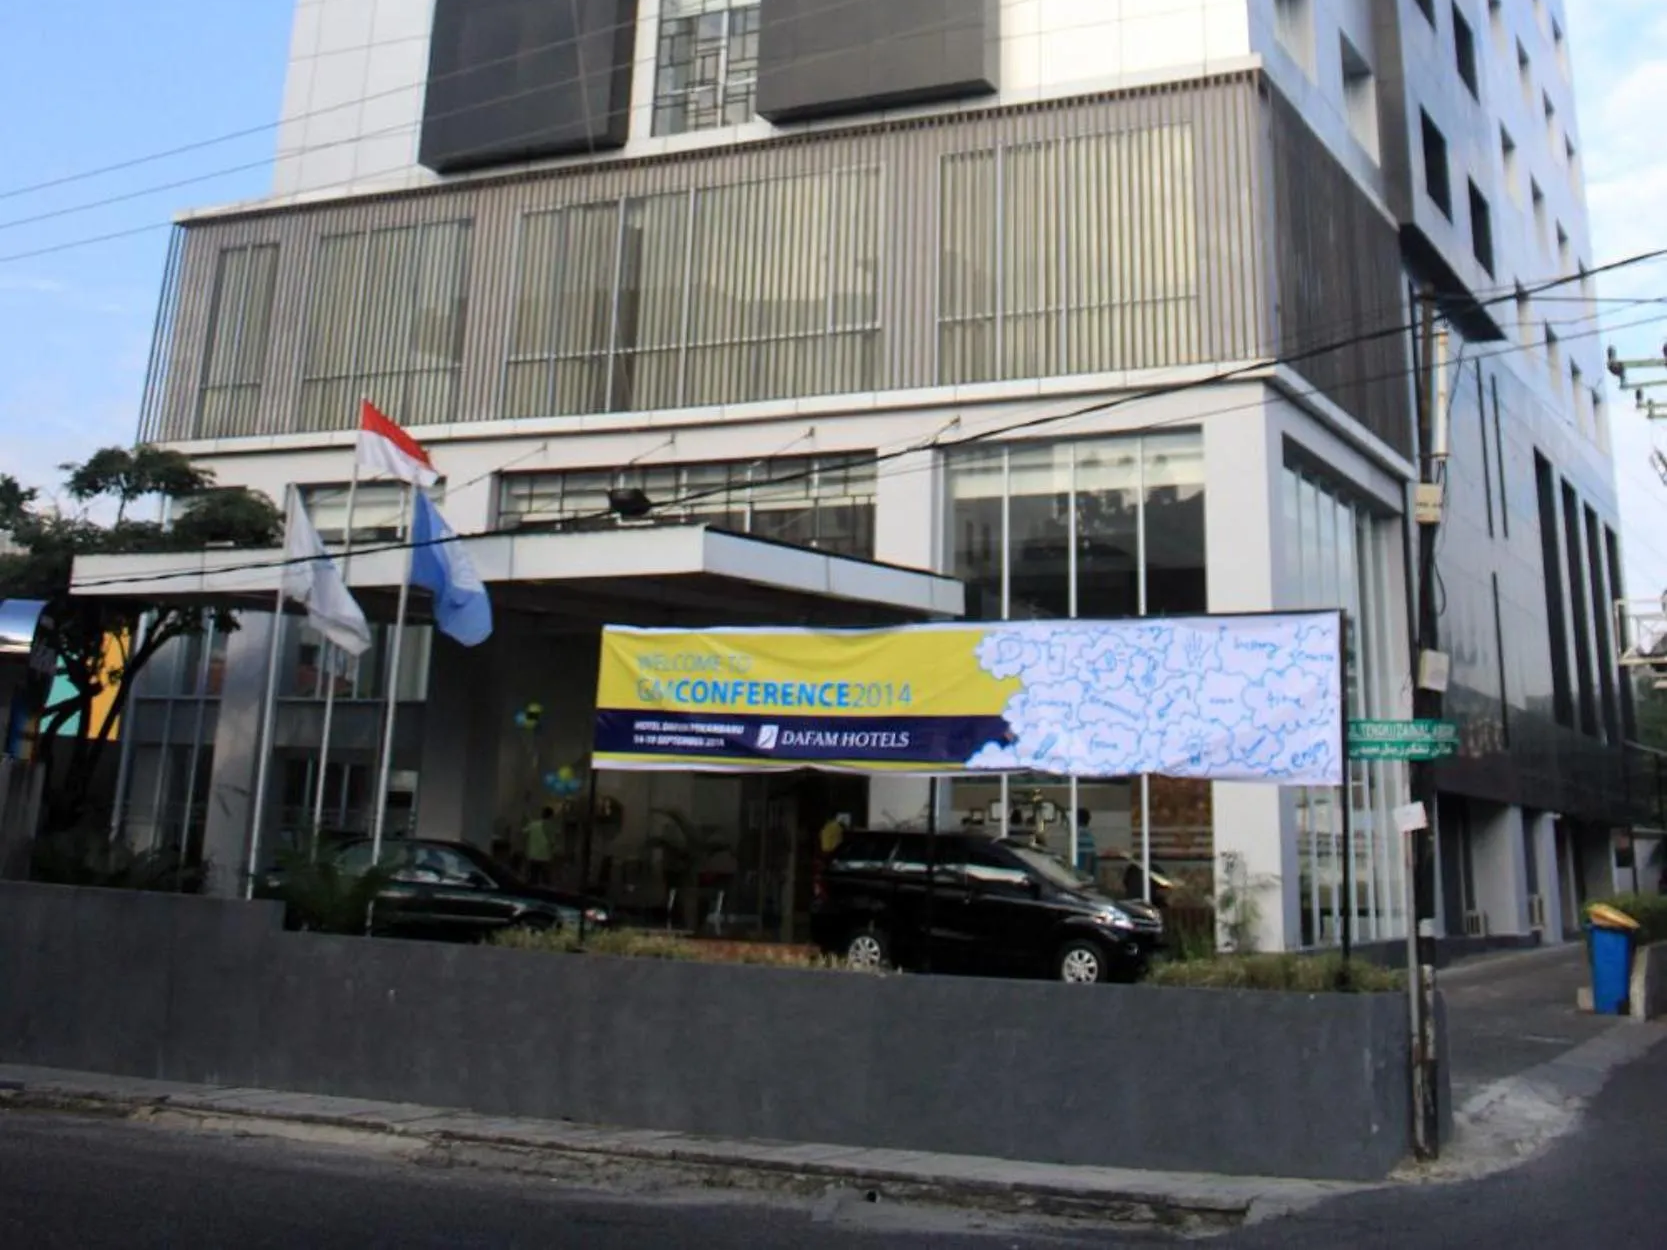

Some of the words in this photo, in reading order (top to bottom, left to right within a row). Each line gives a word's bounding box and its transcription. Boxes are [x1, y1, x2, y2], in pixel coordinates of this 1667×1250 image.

[638, 653, 721, 671] WELCOME
[781, 730, 838, 748] DAFAM
[840, 731, 911, 749] HOTELS
